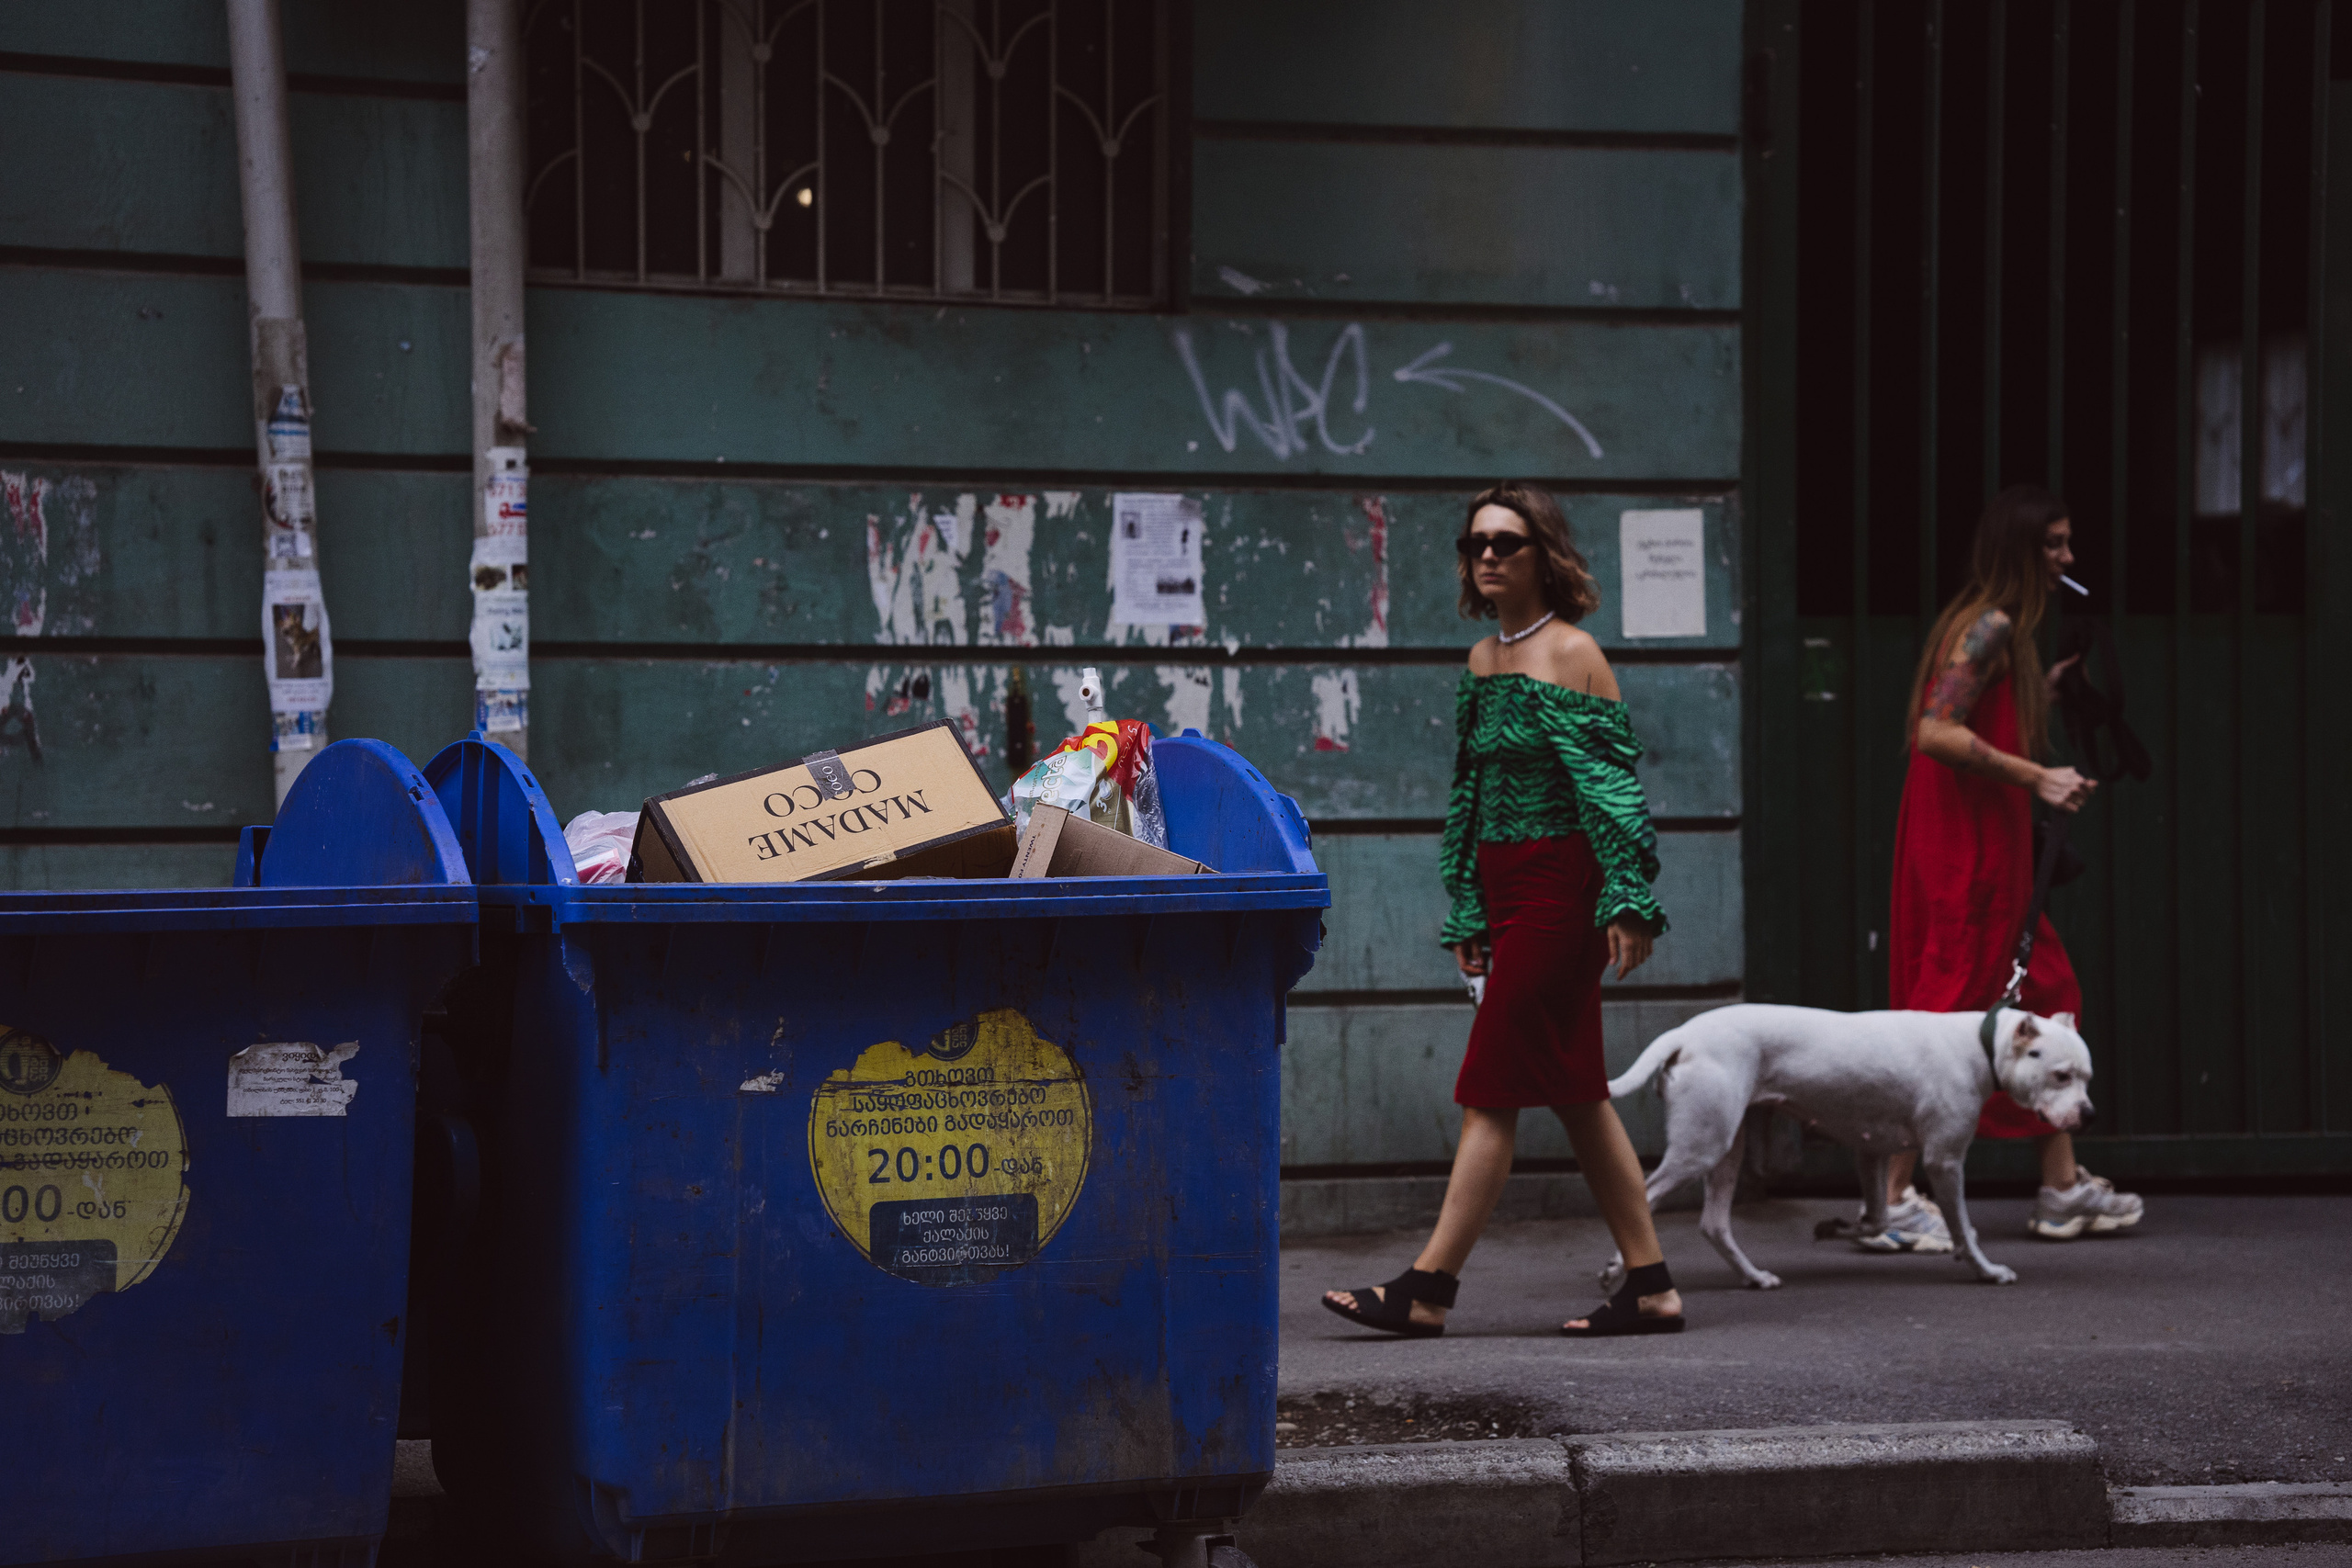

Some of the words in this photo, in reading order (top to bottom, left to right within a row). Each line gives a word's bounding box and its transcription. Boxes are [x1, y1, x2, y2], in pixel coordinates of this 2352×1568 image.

[1096, 799, 1107, 814] 3
[748, 789, 933, 861] MADAME
[1023, 834, 1037, 868] TWENTY
[905, 1066, 994, 1088] გთხოვთ
[826, 1115, 937, 1138] ნარჩენები
[944, 1109, 1074, 1132] გადაყაროთ
[0, 1126, 138, 1146] ცხოვრებო
[14, 1150, 169, 1170] გადაყაროთ
[867, 1143, 989, 1184] 20:00
[903, 1210, 944, 1225] ხელი
[922, 1226, 989, 1244] ქალაქის
[902, 1245, 1010, 1264] განტვითვას!
